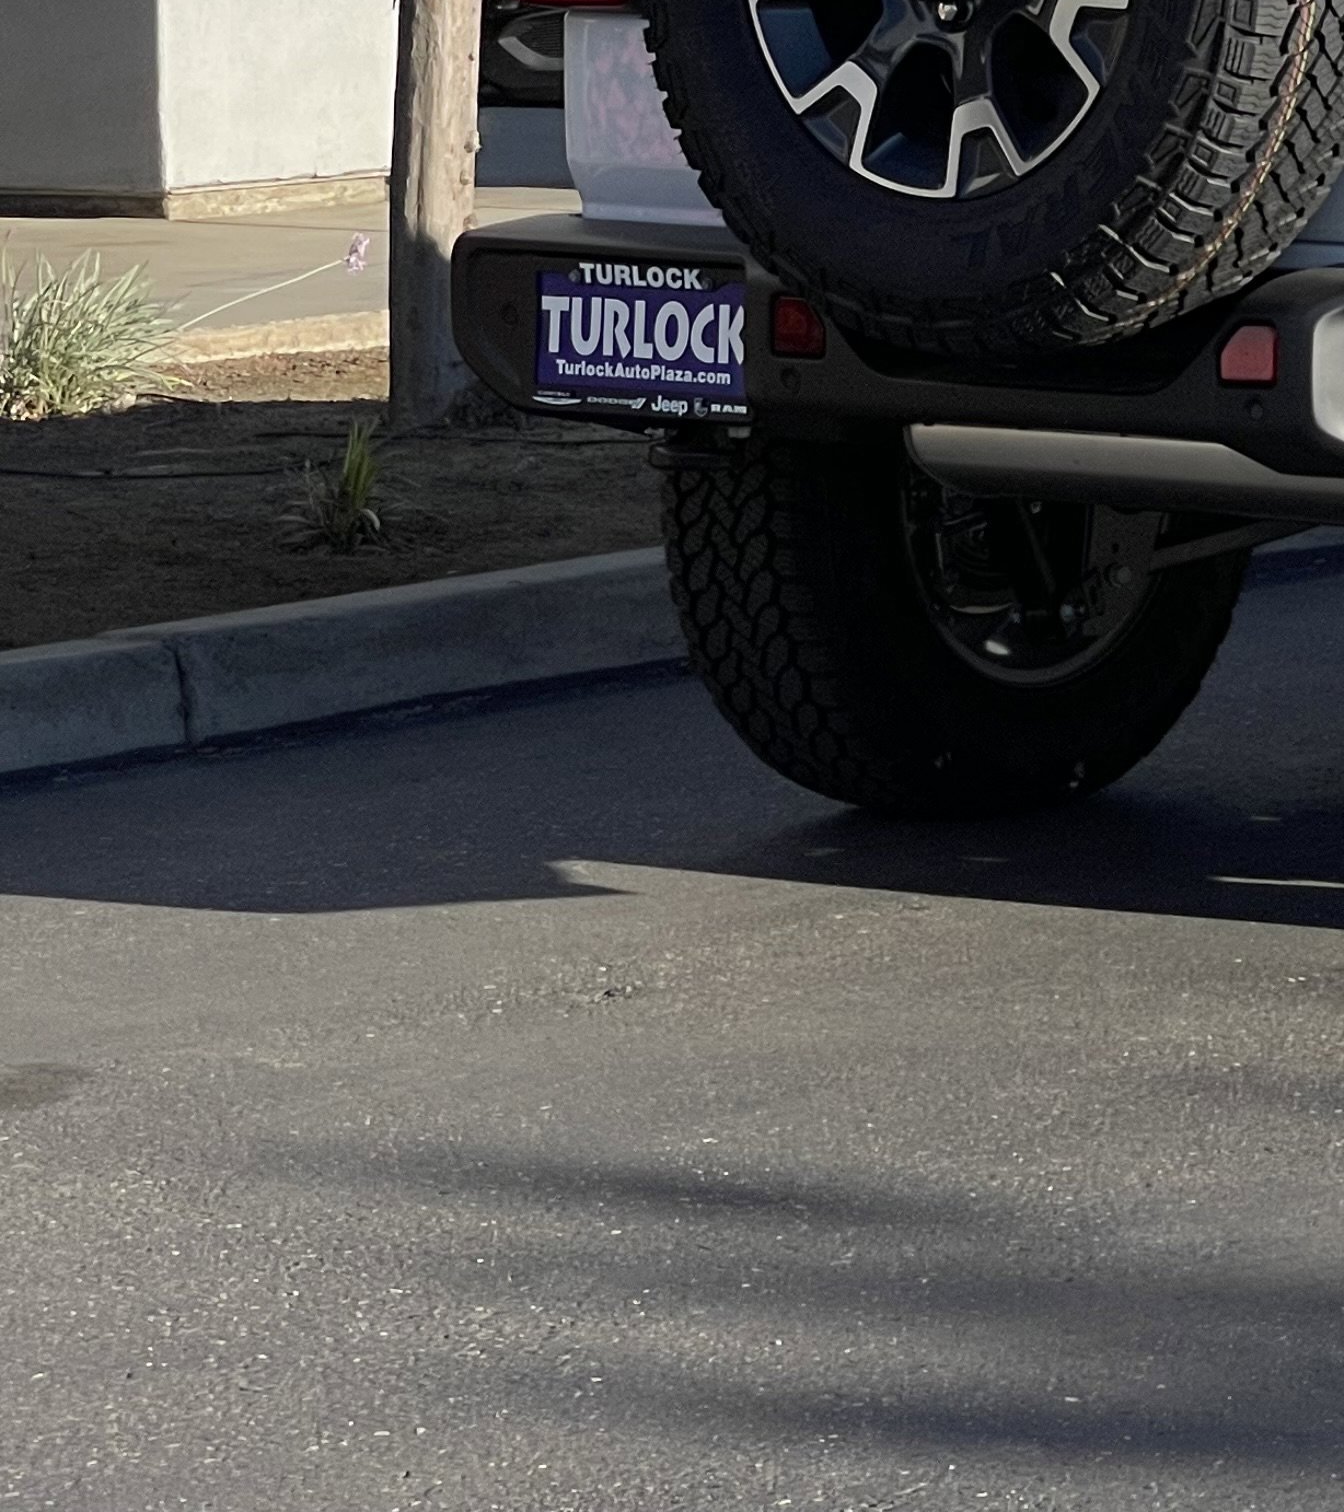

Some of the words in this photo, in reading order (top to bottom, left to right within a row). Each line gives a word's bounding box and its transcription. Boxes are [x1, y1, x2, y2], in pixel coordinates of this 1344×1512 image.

[579, 262, 703, 290] TURLOCK
[541, 295, 744, 365] TURLOCK
[556, 359, 731, 385] TurlockAutoPlaza.com
[651, 395, 688, 416] Jeep
[711, 404, 747, 415] RAM
